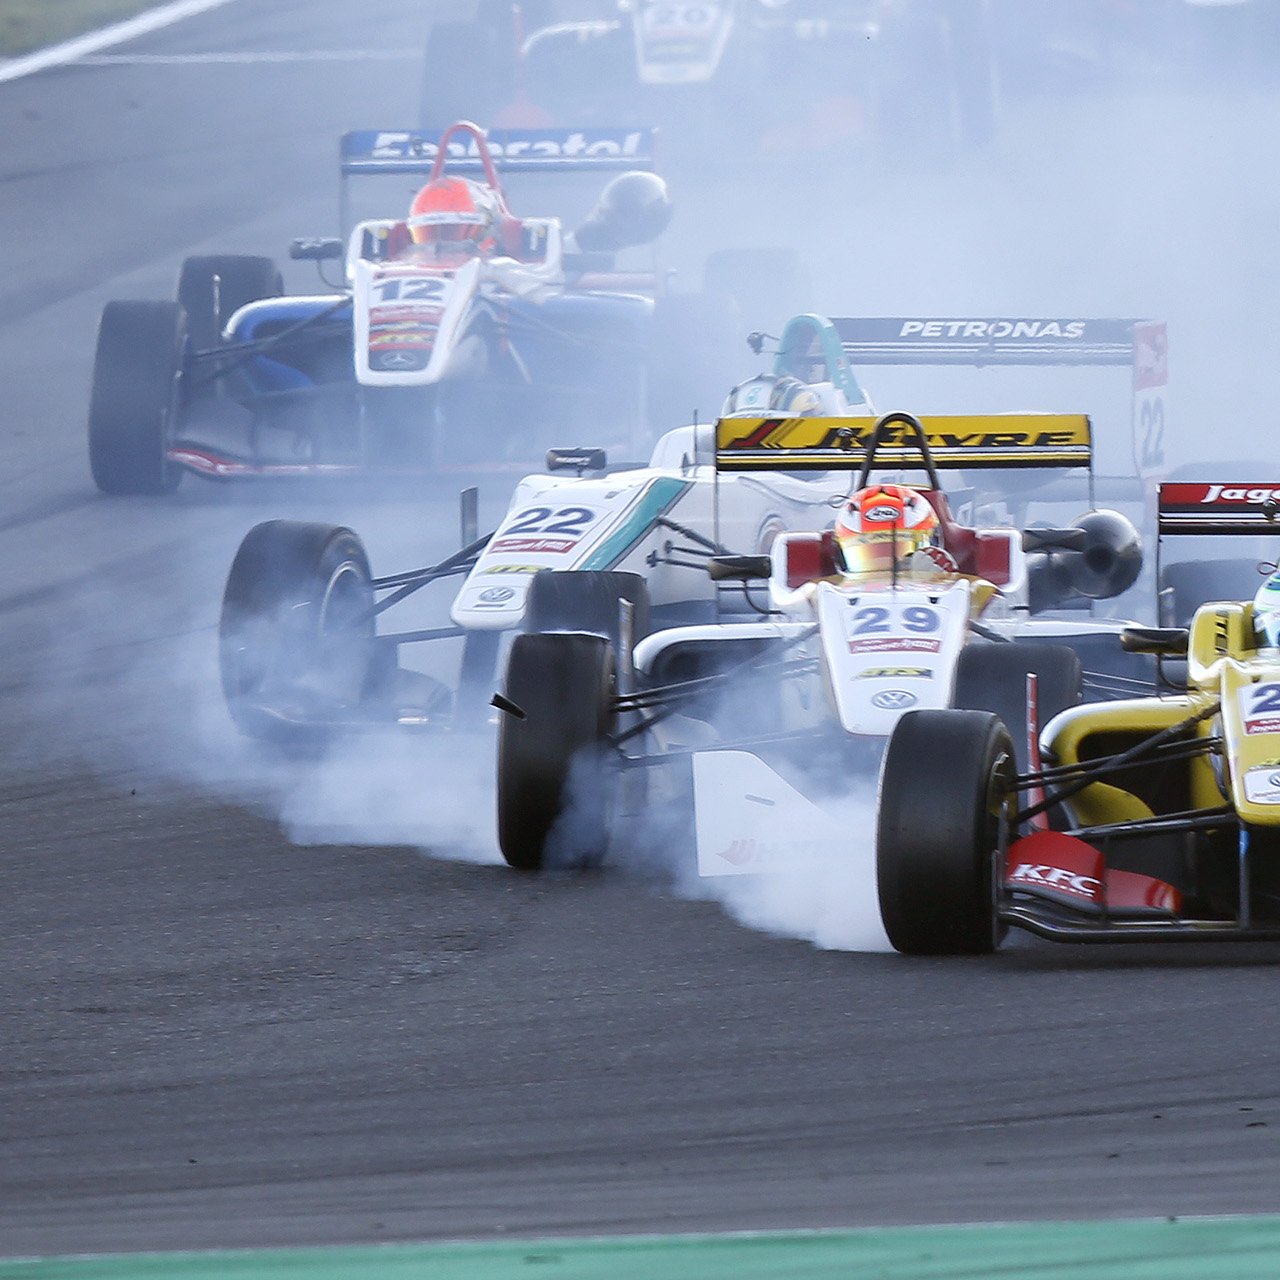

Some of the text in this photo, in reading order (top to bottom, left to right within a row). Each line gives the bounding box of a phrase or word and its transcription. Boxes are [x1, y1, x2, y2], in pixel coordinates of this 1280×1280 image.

[372, 279, 447, 302] 12
[899, 320, 1086, 340] PETRONAS
[499, 506, 596, 537] 22
[851, 606, 942, 635] 29
[1011, 864, 1104, 894] KFC
